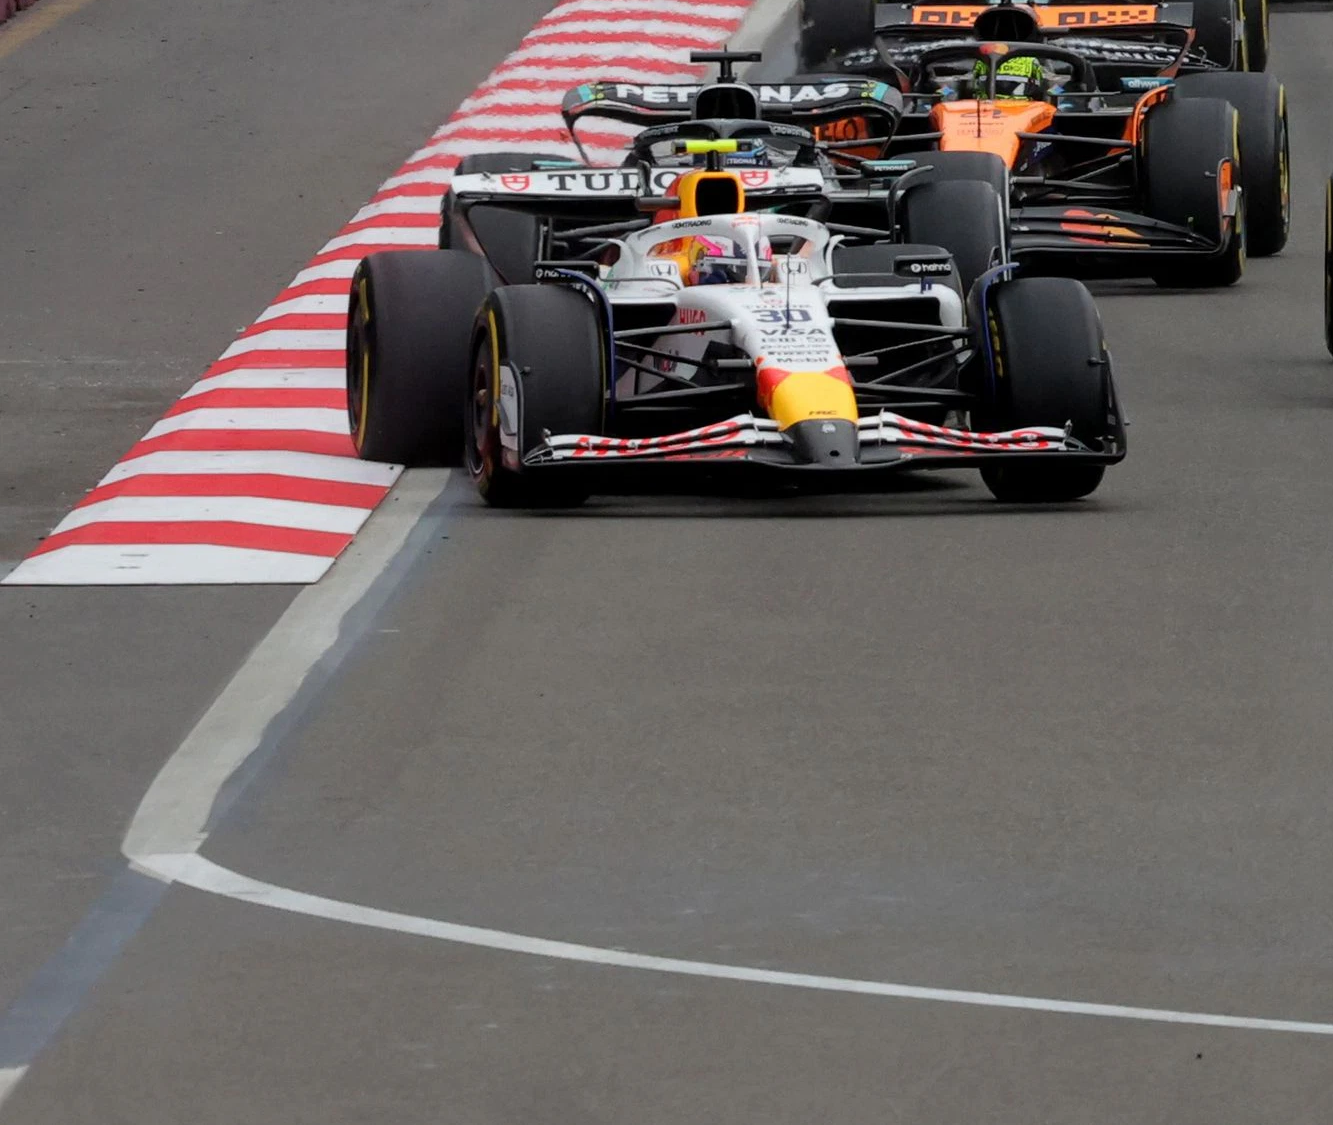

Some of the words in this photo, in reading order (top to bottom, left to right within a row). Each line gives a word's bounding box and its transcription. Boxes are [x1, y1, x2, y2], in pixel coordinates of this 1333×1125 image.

[615, 83, 850, 105] PETNAS
[752, 308, 812, 323] 30
[760, 328, 827, 336] VISA
